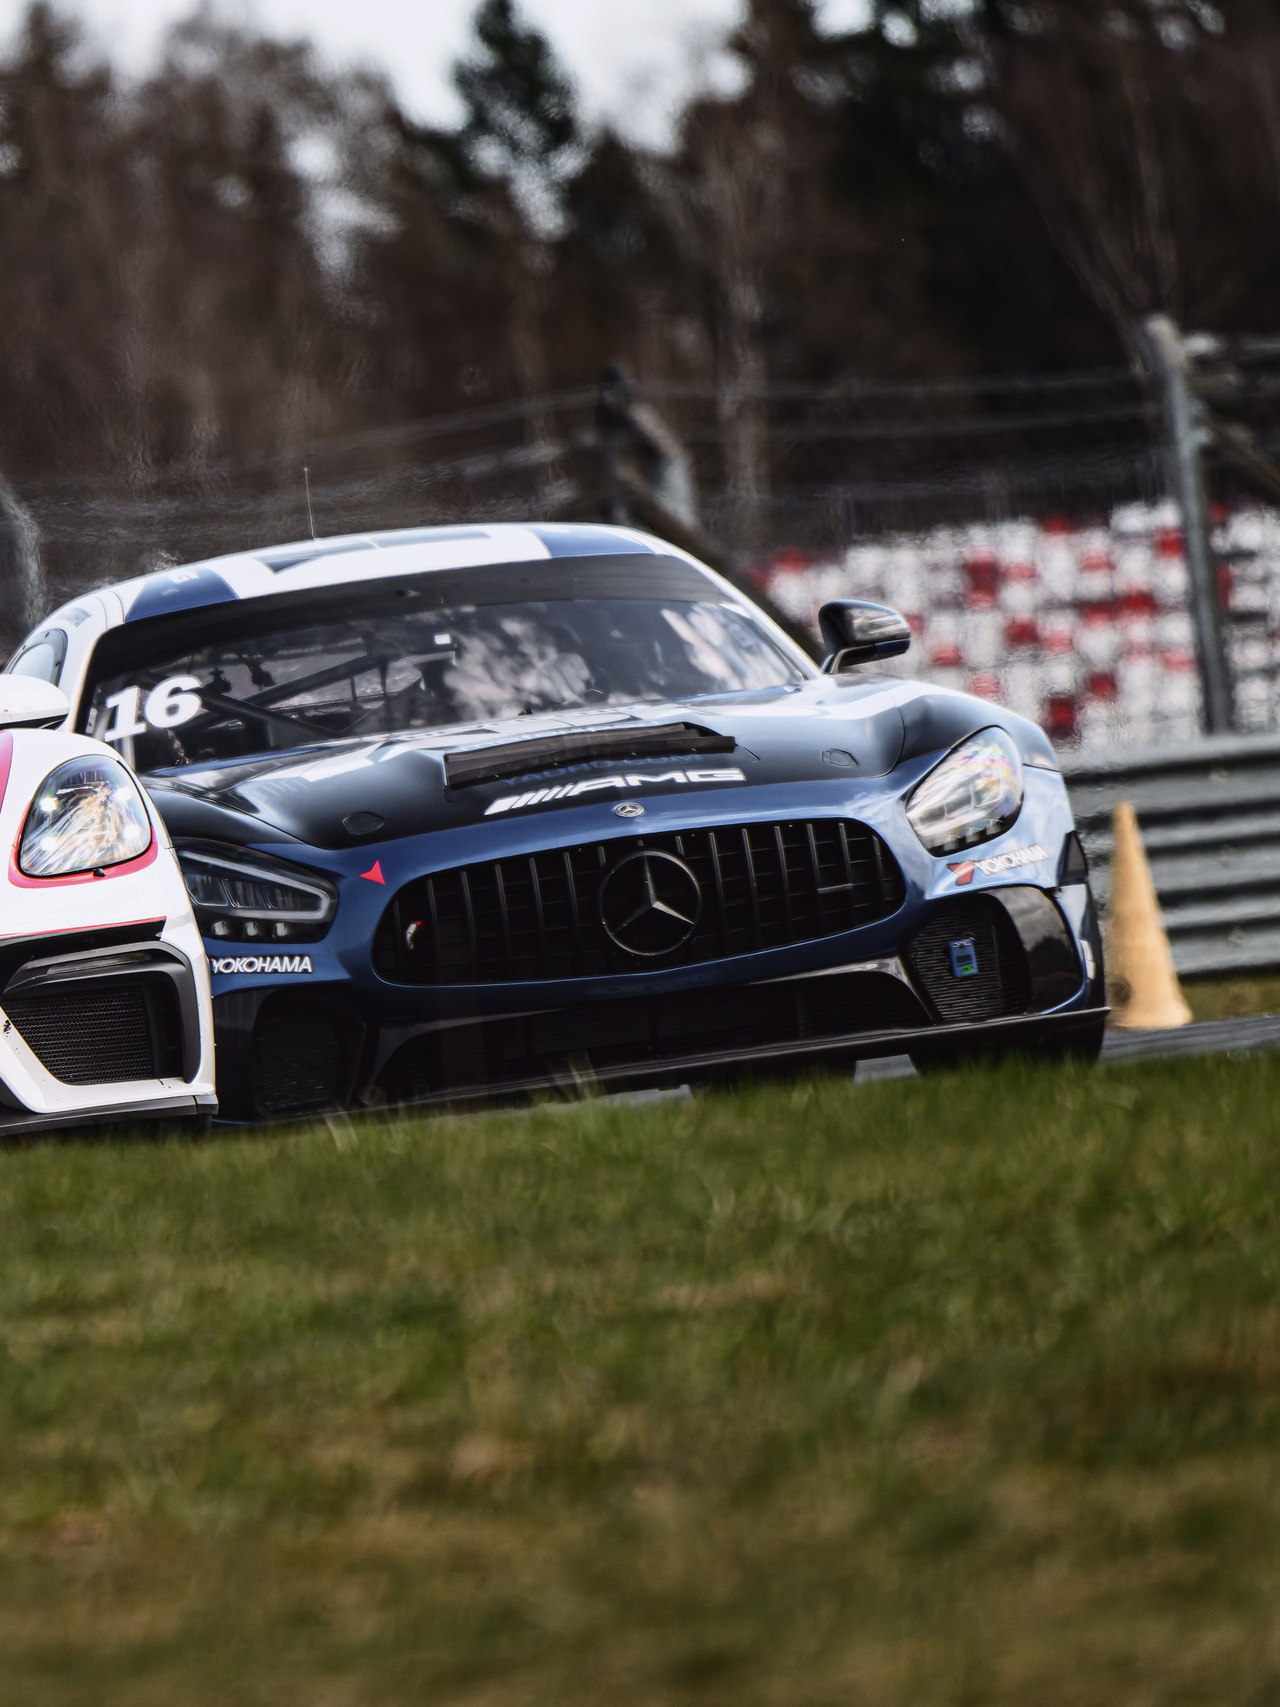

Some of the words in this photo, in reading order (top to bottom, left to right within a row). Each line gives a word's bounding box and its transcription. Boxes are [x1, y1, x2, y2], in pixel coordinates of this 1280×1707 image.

[104, 676, 202, 742] 16
[566, 767, 747, 797] AMG
[975, 843, 1049, 877] YOKOHAMA
[212, 956, 313, 974] YOKOHAMA
